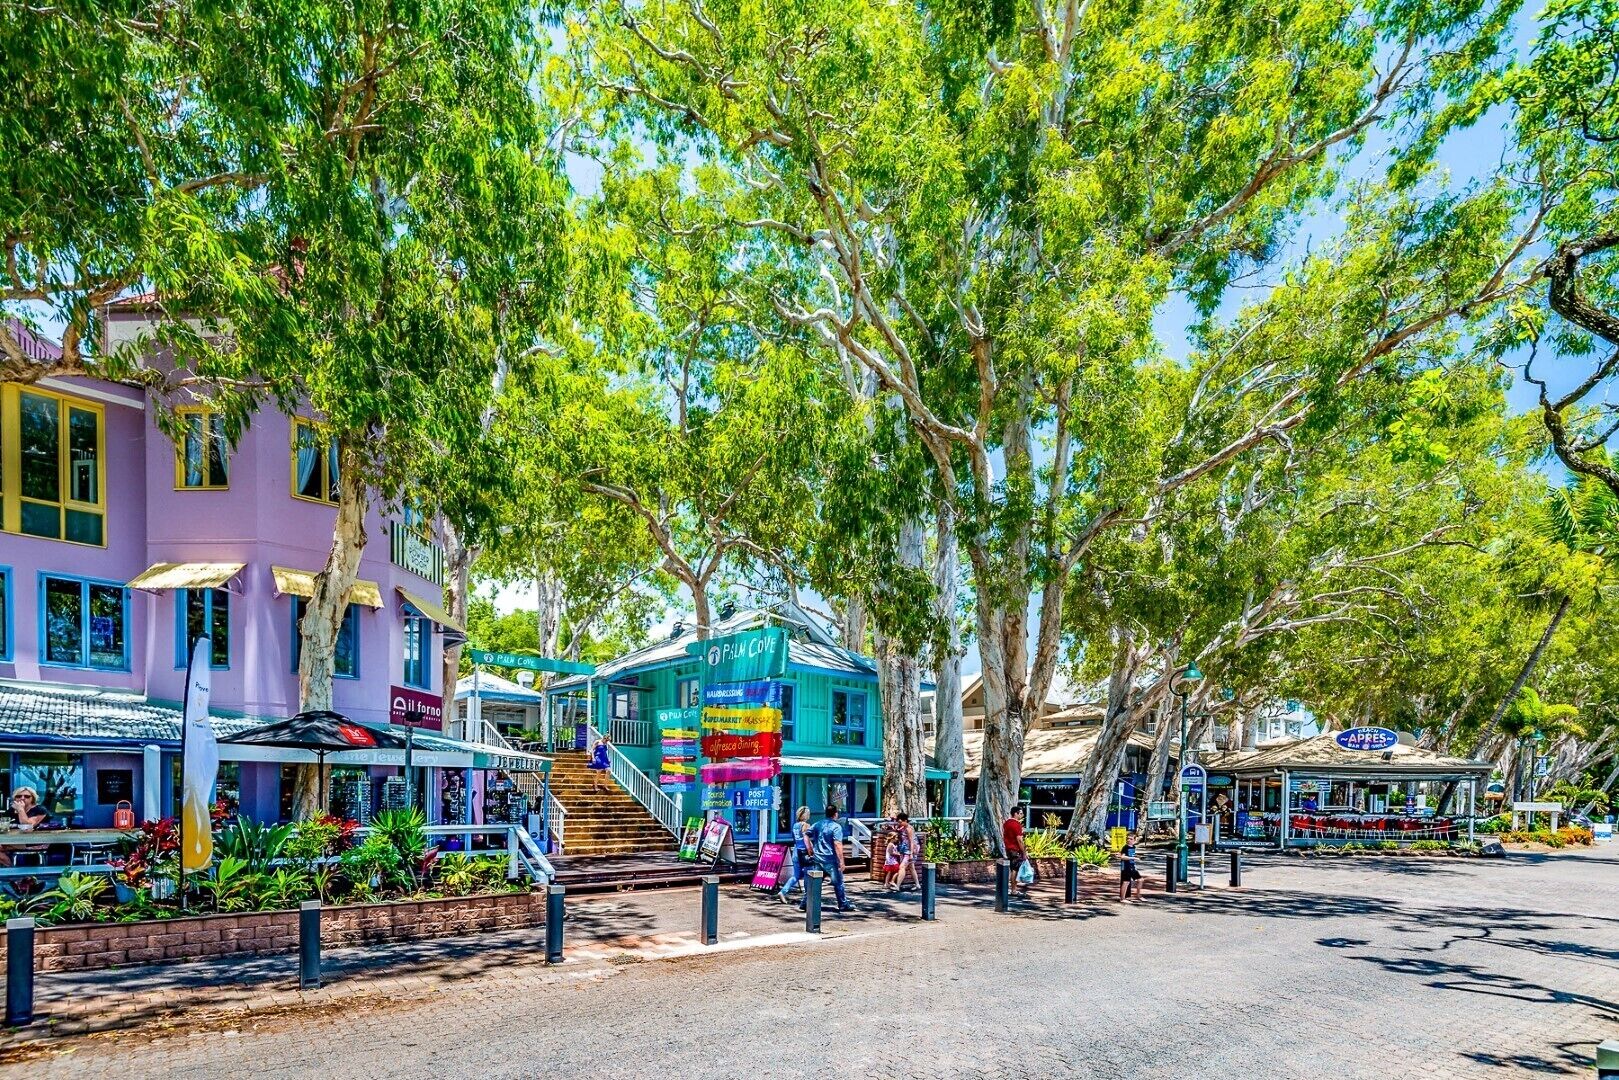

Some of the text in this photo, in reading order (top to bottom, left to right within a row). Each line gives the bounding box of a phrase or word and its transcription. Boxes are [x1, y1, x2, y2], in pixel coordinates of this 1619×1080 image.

[722, 635, 777, 664] PALM COVE
[497, 654, 515, 664] PALM
[706, 688, 744, 699] HAIRDRESSING
[408, 699, 441, 717] il forno
[703, 712, 743, 724] SUPERMARKET
[1348, 733, 1387, 744] APRES
[748, 790, 765, 798] POST
[745, 798, 769, 807] OFFICE
